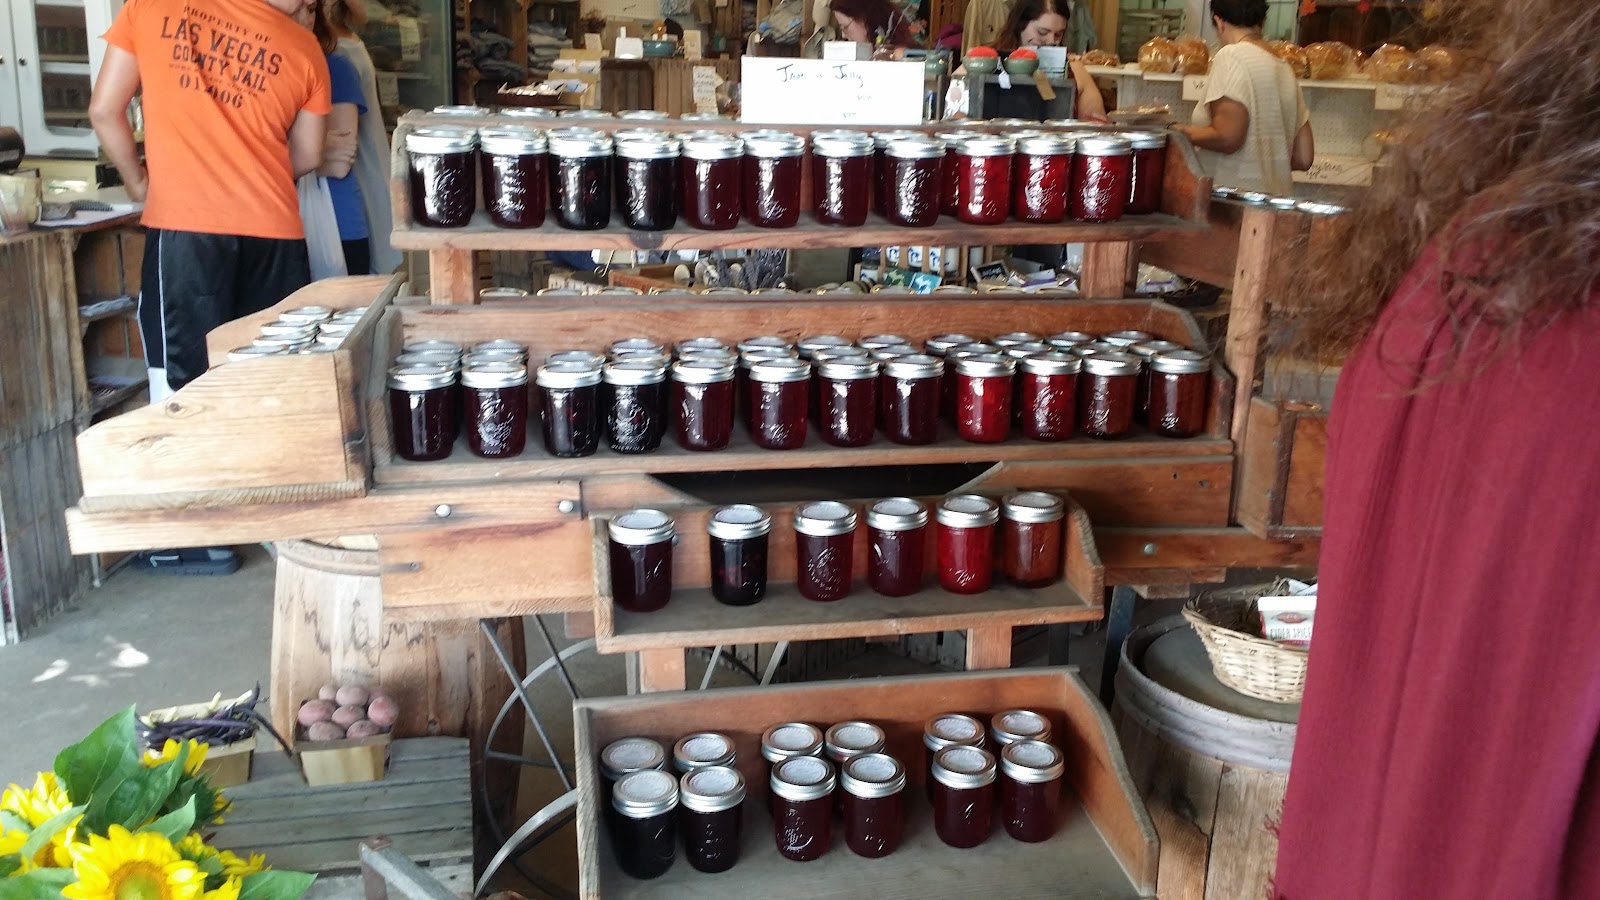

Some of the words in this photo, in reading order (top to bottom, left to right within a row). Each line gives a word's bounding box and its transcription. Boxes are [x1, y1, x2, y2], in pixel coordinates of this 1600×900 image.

[160, 15, 202, 46] LAS
[209, 28, 283, 76] VEGAS
[184, 7, 249, 35] PROPERTY
[255, 33, 271, 42] OF
[172, 43, 230, 76] COUNTY
[232, 66, 268, 93] JAIL
